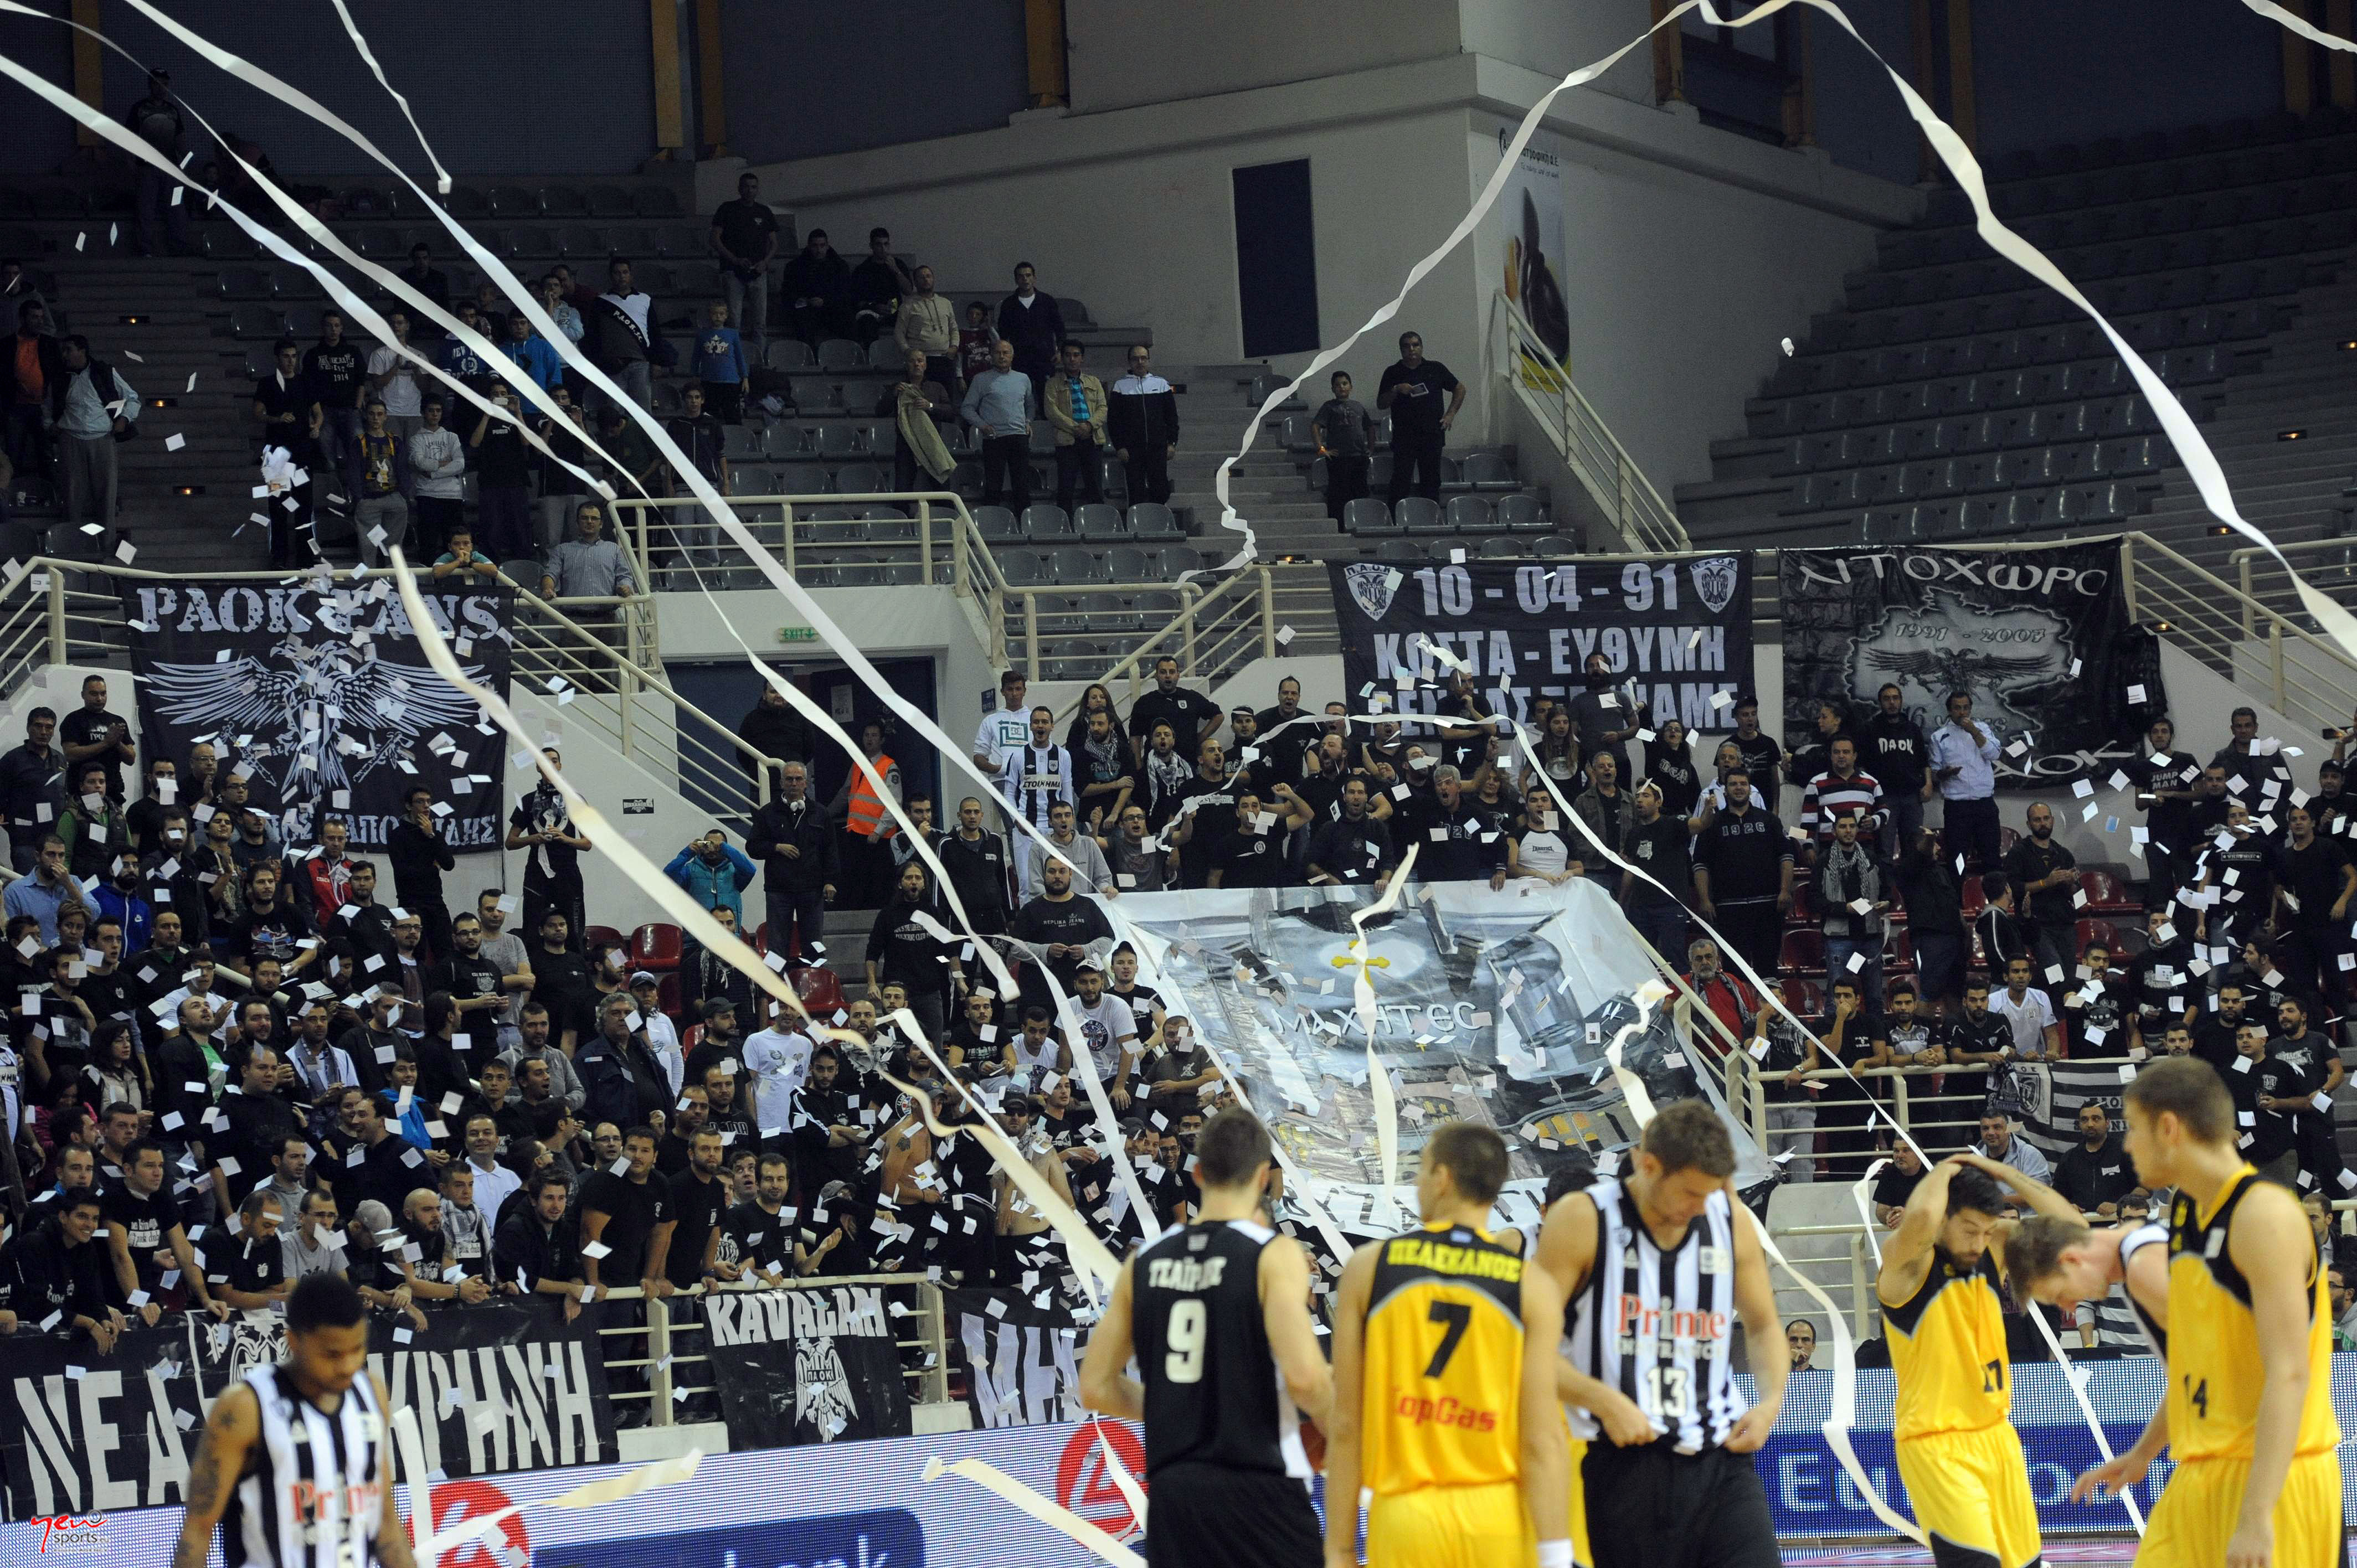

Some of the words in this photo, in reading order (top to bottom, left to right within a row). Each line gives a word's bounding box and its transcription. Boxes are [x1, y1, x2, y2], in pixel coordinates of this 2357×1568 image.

[333, 374, 349, 382] 1914
[1413, 564, 1474, 617] 10
[1515, 564, 1583, 615] 04
[1620, 563, 1678, 612] 91
[136, 587, 312, 633] PAOK
[784, 629, 804, 639] EXIT
[1895, 623, 1948, 641] 1991
[1980, 628, 2046, 643] 2007
[1373, 631, 1516, 679] ΚΩΣΤΑ
[1549, 626, 1725, 672] ΕΥΘΥΜΗ
[2150, 771, 2179, 782] JUMP
[2153, 780, 2178, 789] MAN
[1722, 821, 1766, 837] 1926
[1618, 1293, 1726, 1339] Prime
[1166, 1299, 1206, 1384] 9
[1424, 1301, 1473, 1378] 7
[807, 1370, 834, 1383] ΠΑΟΚ
[1647, 1366, 1687, 1417] 13
